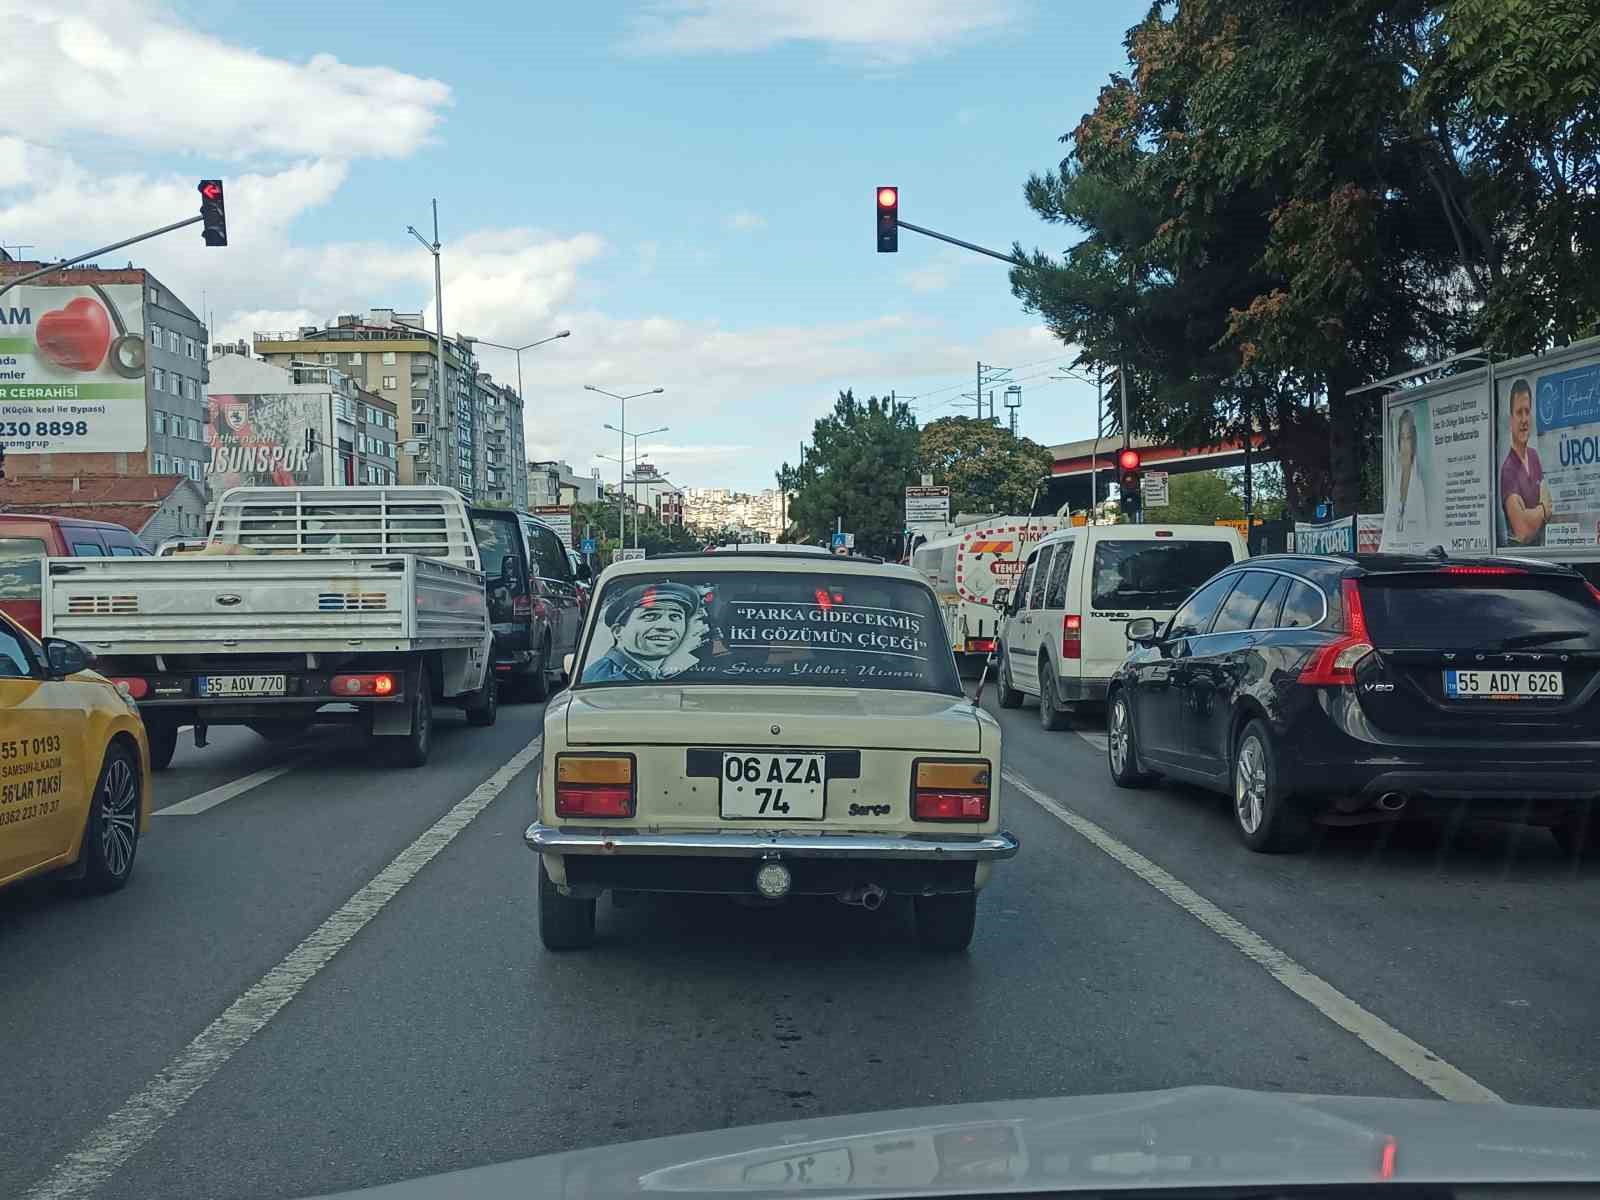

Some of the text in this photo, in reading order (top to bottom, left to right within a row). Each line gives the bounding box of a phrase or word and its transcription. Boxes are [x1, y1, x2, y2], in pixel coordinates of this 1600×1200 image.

[10, 385, 78, 398] CERRAHİSİ
[70, 405, 105, 415] Bypass)
[36, 421, 88, 436] 8898
[808, 608, 921, 634] GİDECEKMİŞ
[731, 625, 757, 640] İKİ
[761, 626, 853, 644] GÖZÜMÜN
[207, 678, 223, 692] 55
[260, 676, 283, 690] 770
[1458, 673, 1558, 692] 55 ADY 626
[2, 735, 60, 759] 55 T 0193
[725, 756, 821, 784] 06 AZA
[755, 787, 790, 814] 74
